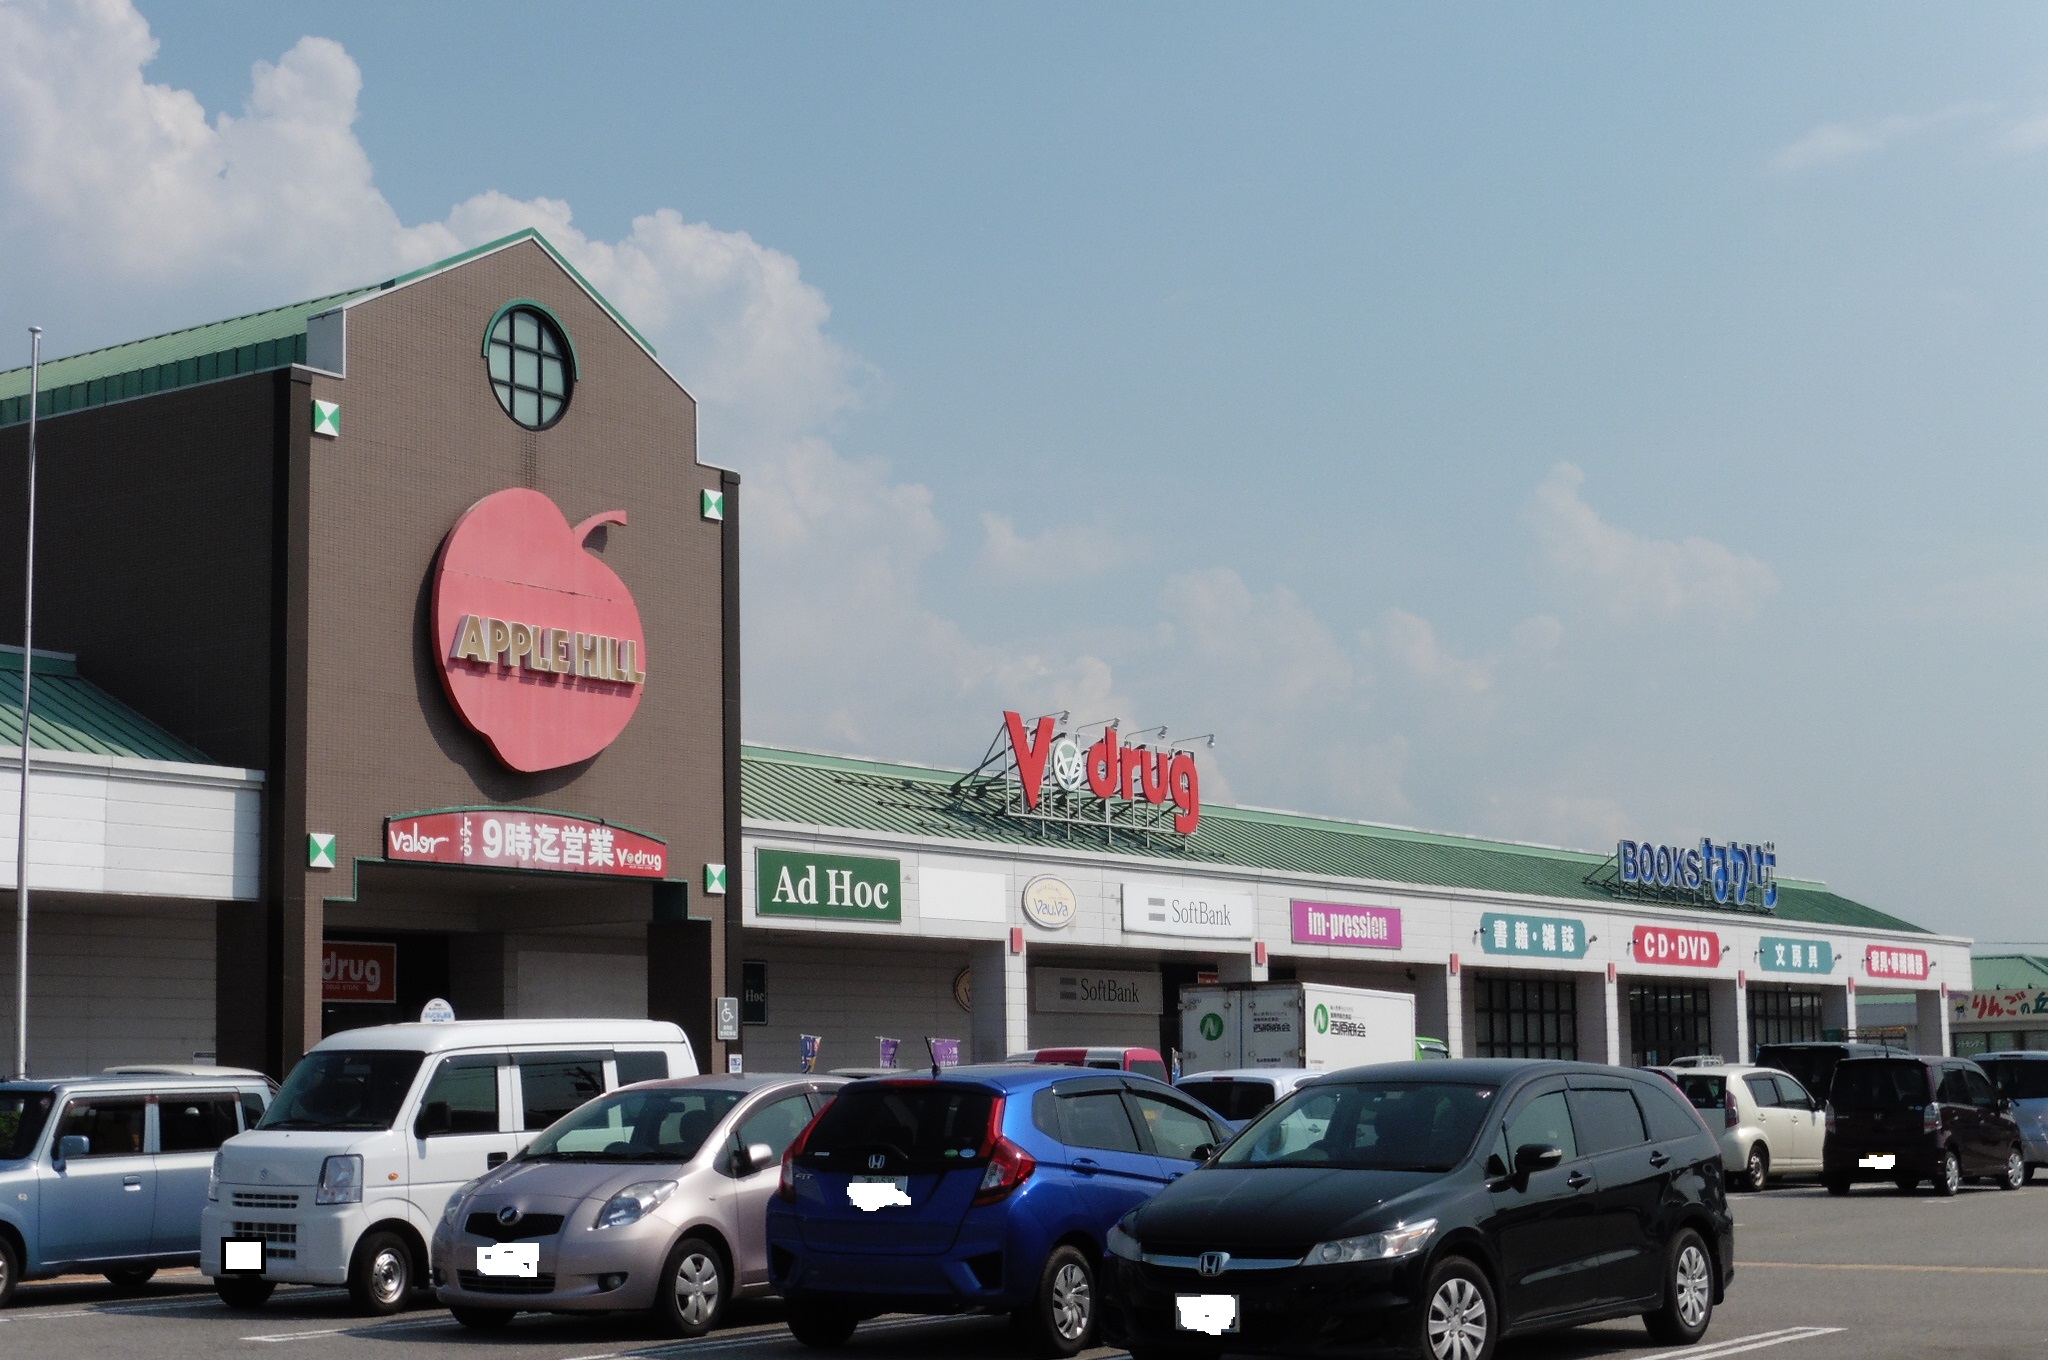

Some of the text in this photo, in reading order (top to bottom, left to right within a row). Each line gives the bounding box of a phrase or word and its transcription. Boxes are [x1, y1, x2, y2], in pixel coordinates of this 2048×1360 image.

[453, 614, 646, 684] APPLE HILL
[1618, 838, 1702, 890] BOOKS
[771, 864, 890, 910] Ad Hoc
[1172, 899, 1232, 927] SoftBank
[322, 950, 382, 992] drug
[1080, 978, 1140, 1003] SoftBank
[745, 989, 765, 1003] Hoc
